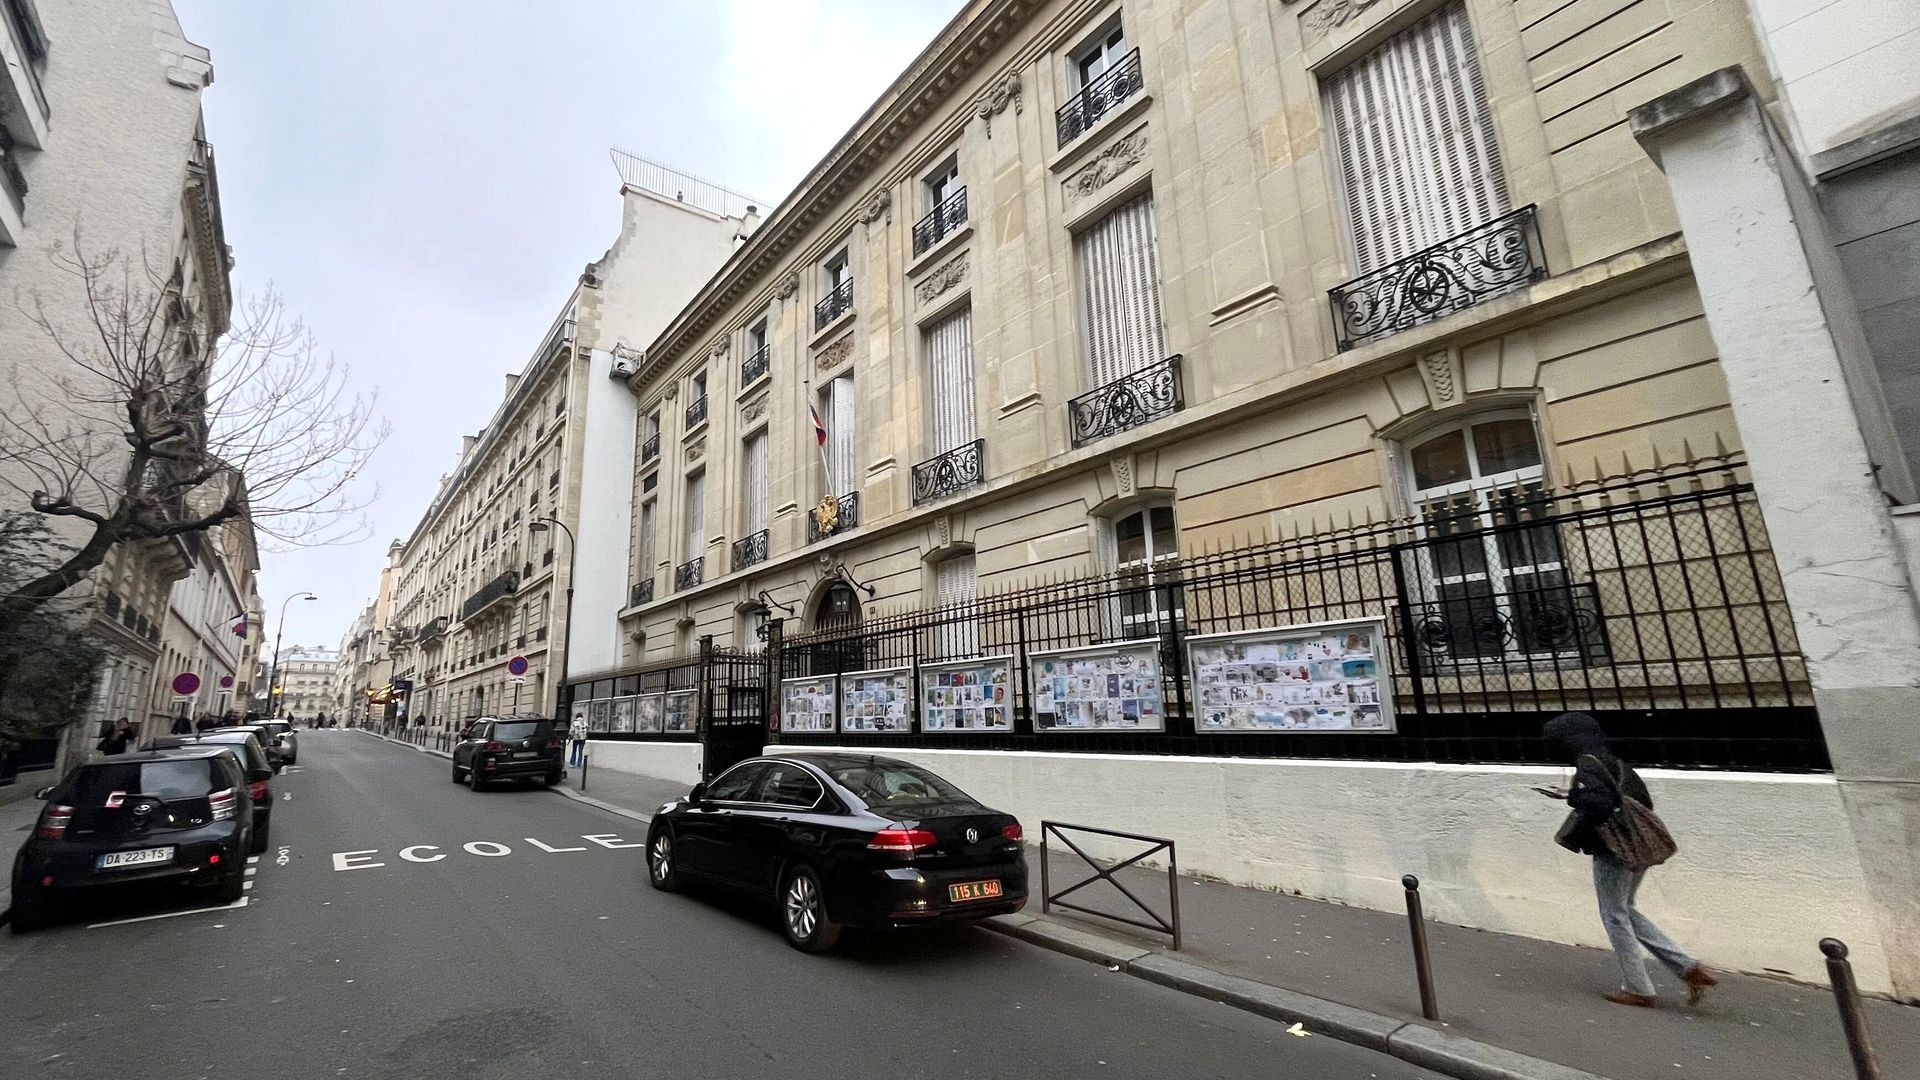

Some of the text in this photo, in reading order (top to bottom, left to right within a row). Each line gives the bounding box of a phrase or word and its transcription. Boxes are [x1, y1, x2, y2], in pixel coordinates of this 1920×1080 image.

[106, 849, 164, 865] DA-223-TS
[332, 833, 647, 872] ECOLE
[953, 881, 999, 899] 115 K 640
